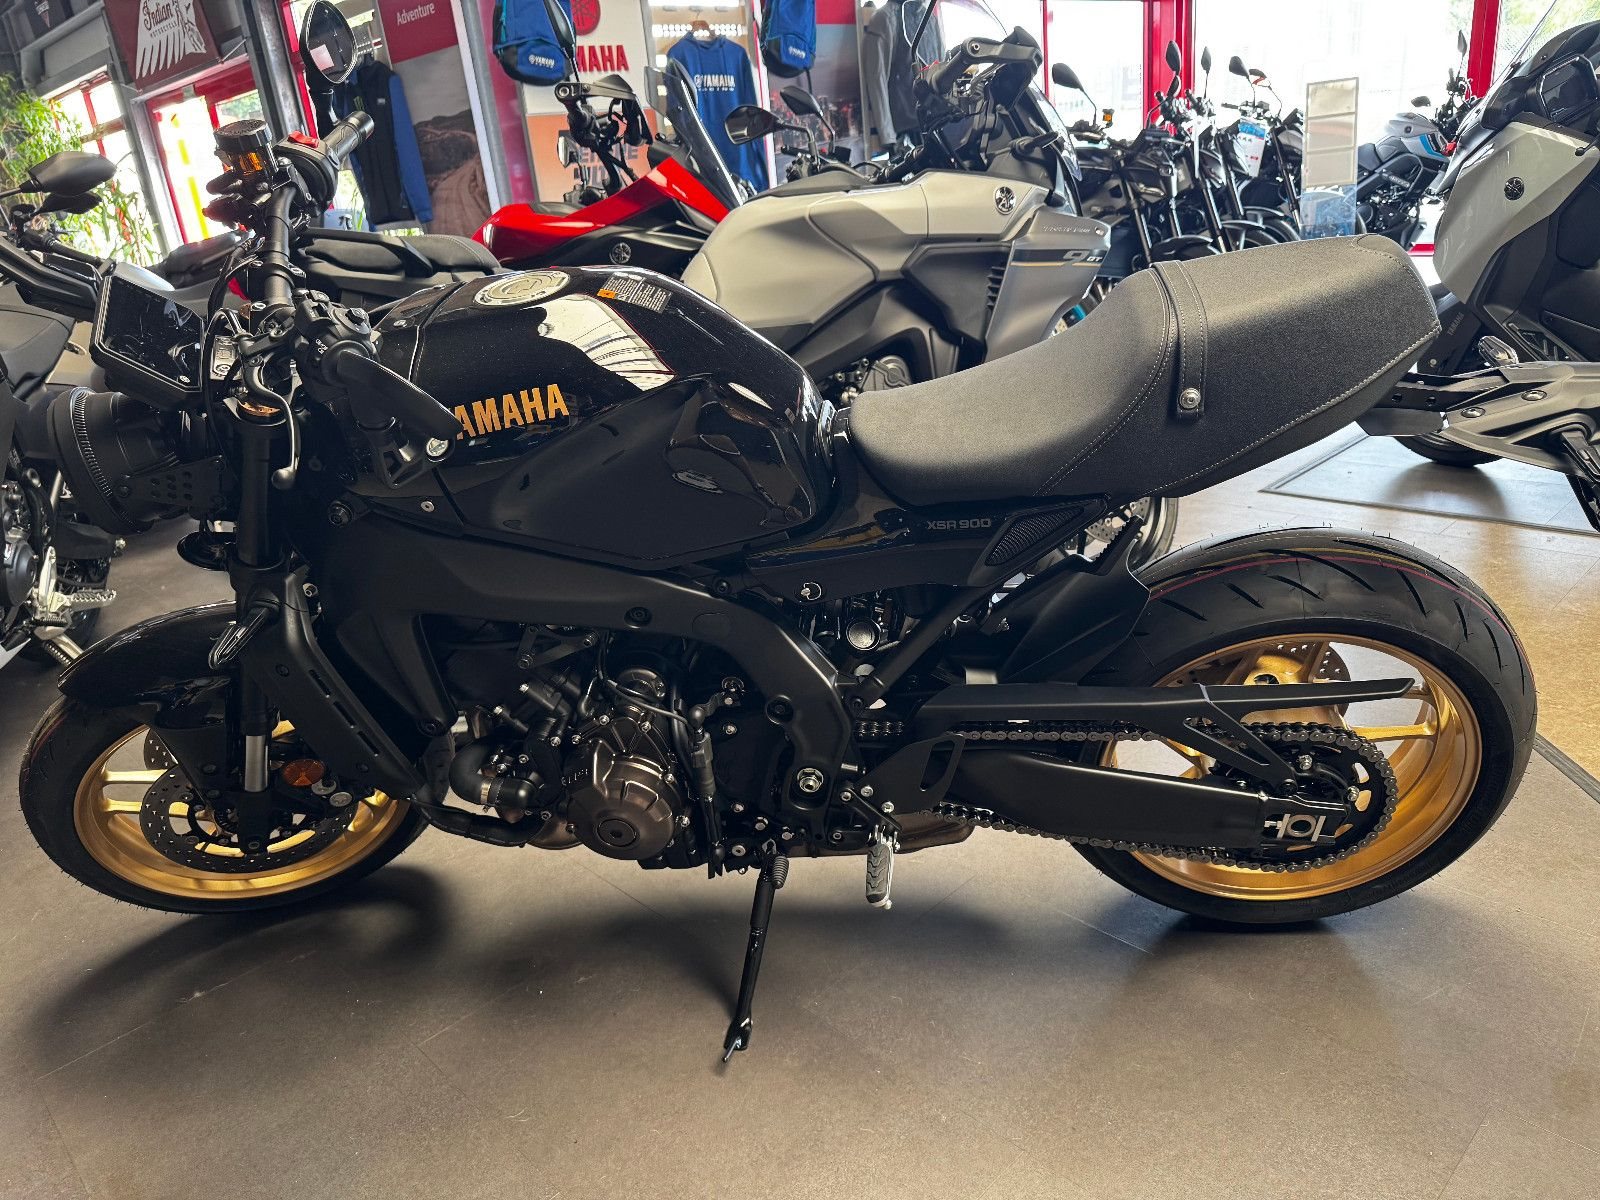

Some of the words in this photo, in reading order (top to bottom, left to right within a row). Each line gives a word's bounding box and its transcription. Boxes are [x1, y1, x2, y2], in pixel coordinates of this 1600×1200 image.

[143, 0, 174, 31] Indian
[396, 3, 435, 26] Adventure
[576, 45, 629, 72] MAHA
[702, 74, 735, 87] YAMAHA
[454, 384, 569, 440] AMAHA
[927, 520, 957, 530] XSR
[960, 518, 992, 529] 900
